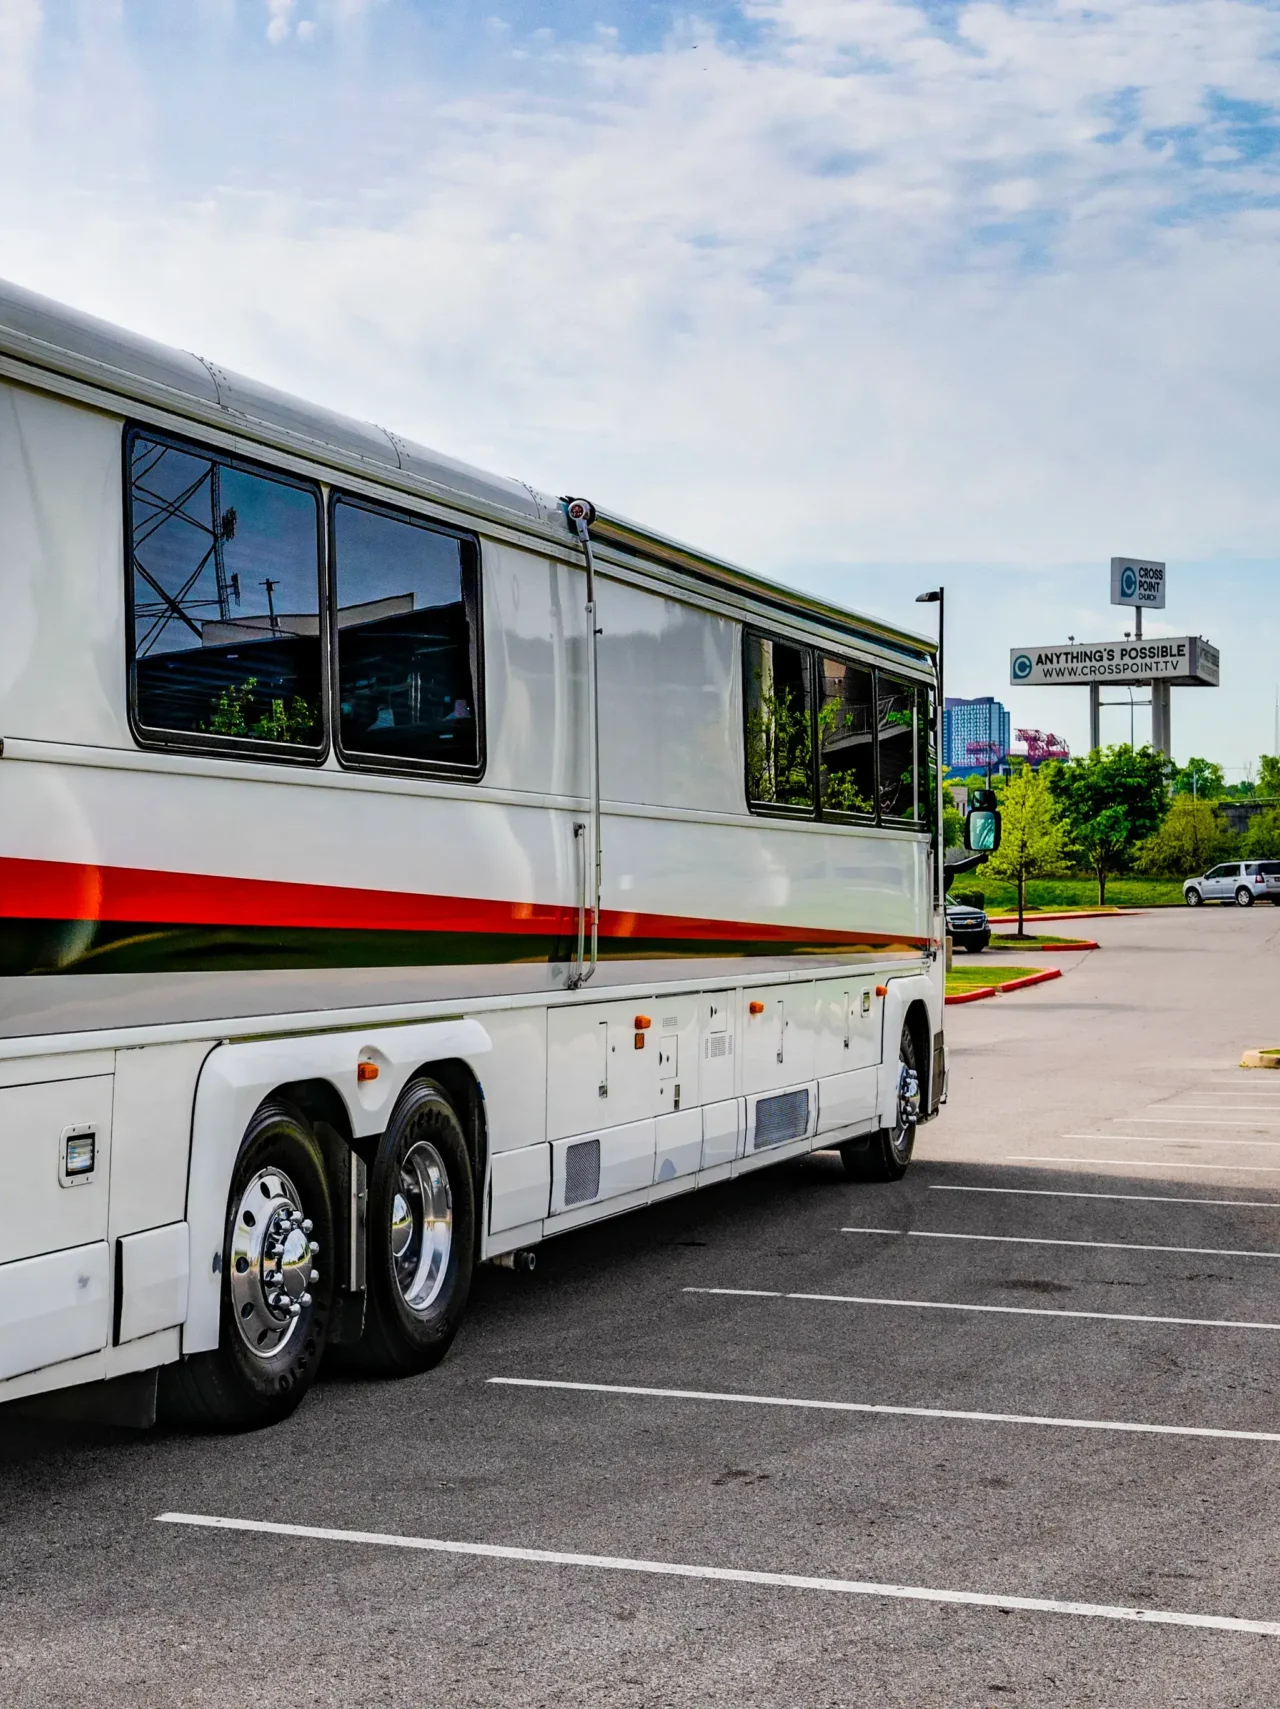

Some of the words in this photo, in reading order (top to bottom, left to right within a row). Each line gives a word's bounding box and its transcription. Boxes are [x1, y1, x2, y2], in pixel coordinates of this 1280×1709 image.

[1138, 567, 1163, 580] CROSS
[1138, 580, 1160, 592] POINT
[1138, 593, 1157, 601] CHURCH
[1036, 648, 1115, 666] ANYTHING'S
[1120, 644, 1186, 661] POSSIBLE
[1042, 660, 1180, 679] WWW.CROSSPOINT.TV
